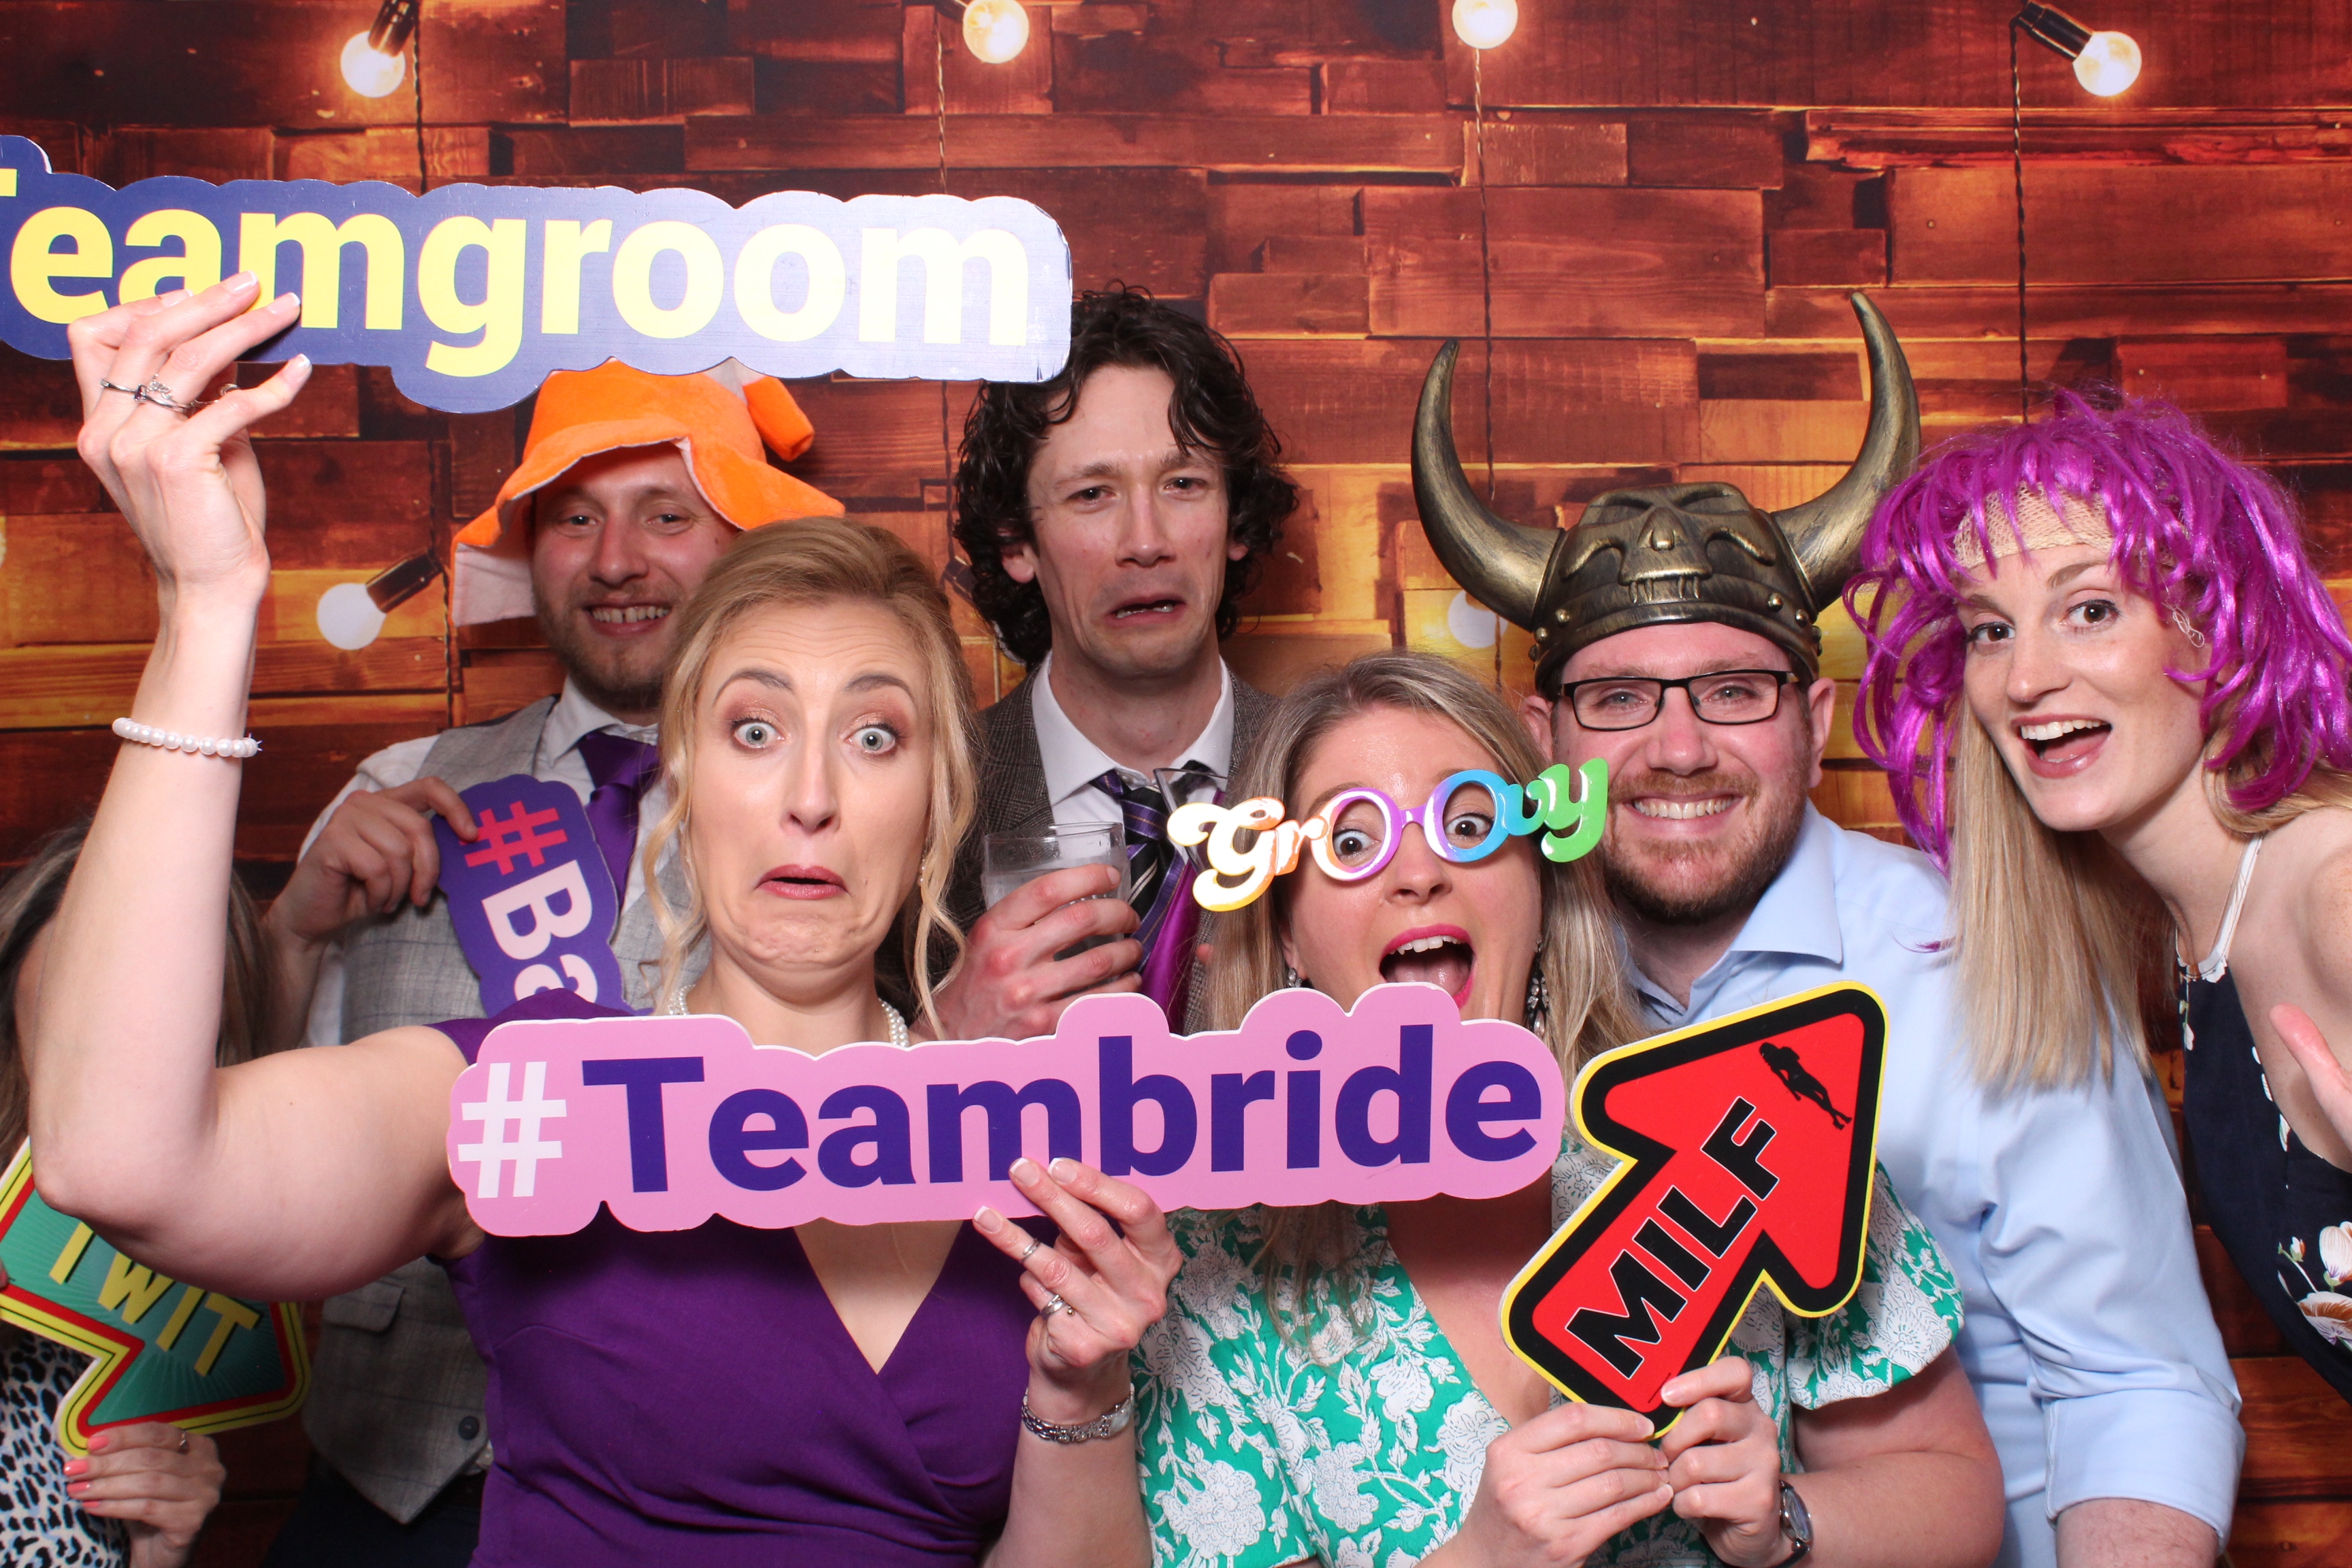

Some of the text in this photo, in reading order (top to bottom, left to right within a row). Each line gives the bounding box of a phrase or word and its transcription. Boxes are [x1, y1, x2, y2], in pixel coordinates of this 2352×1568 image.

[0, 168, 1029, 377] eamgroom
[457, 1024, 1542, 1198] #Teambride
[1565, 1096, 1780, 1379] MILF
